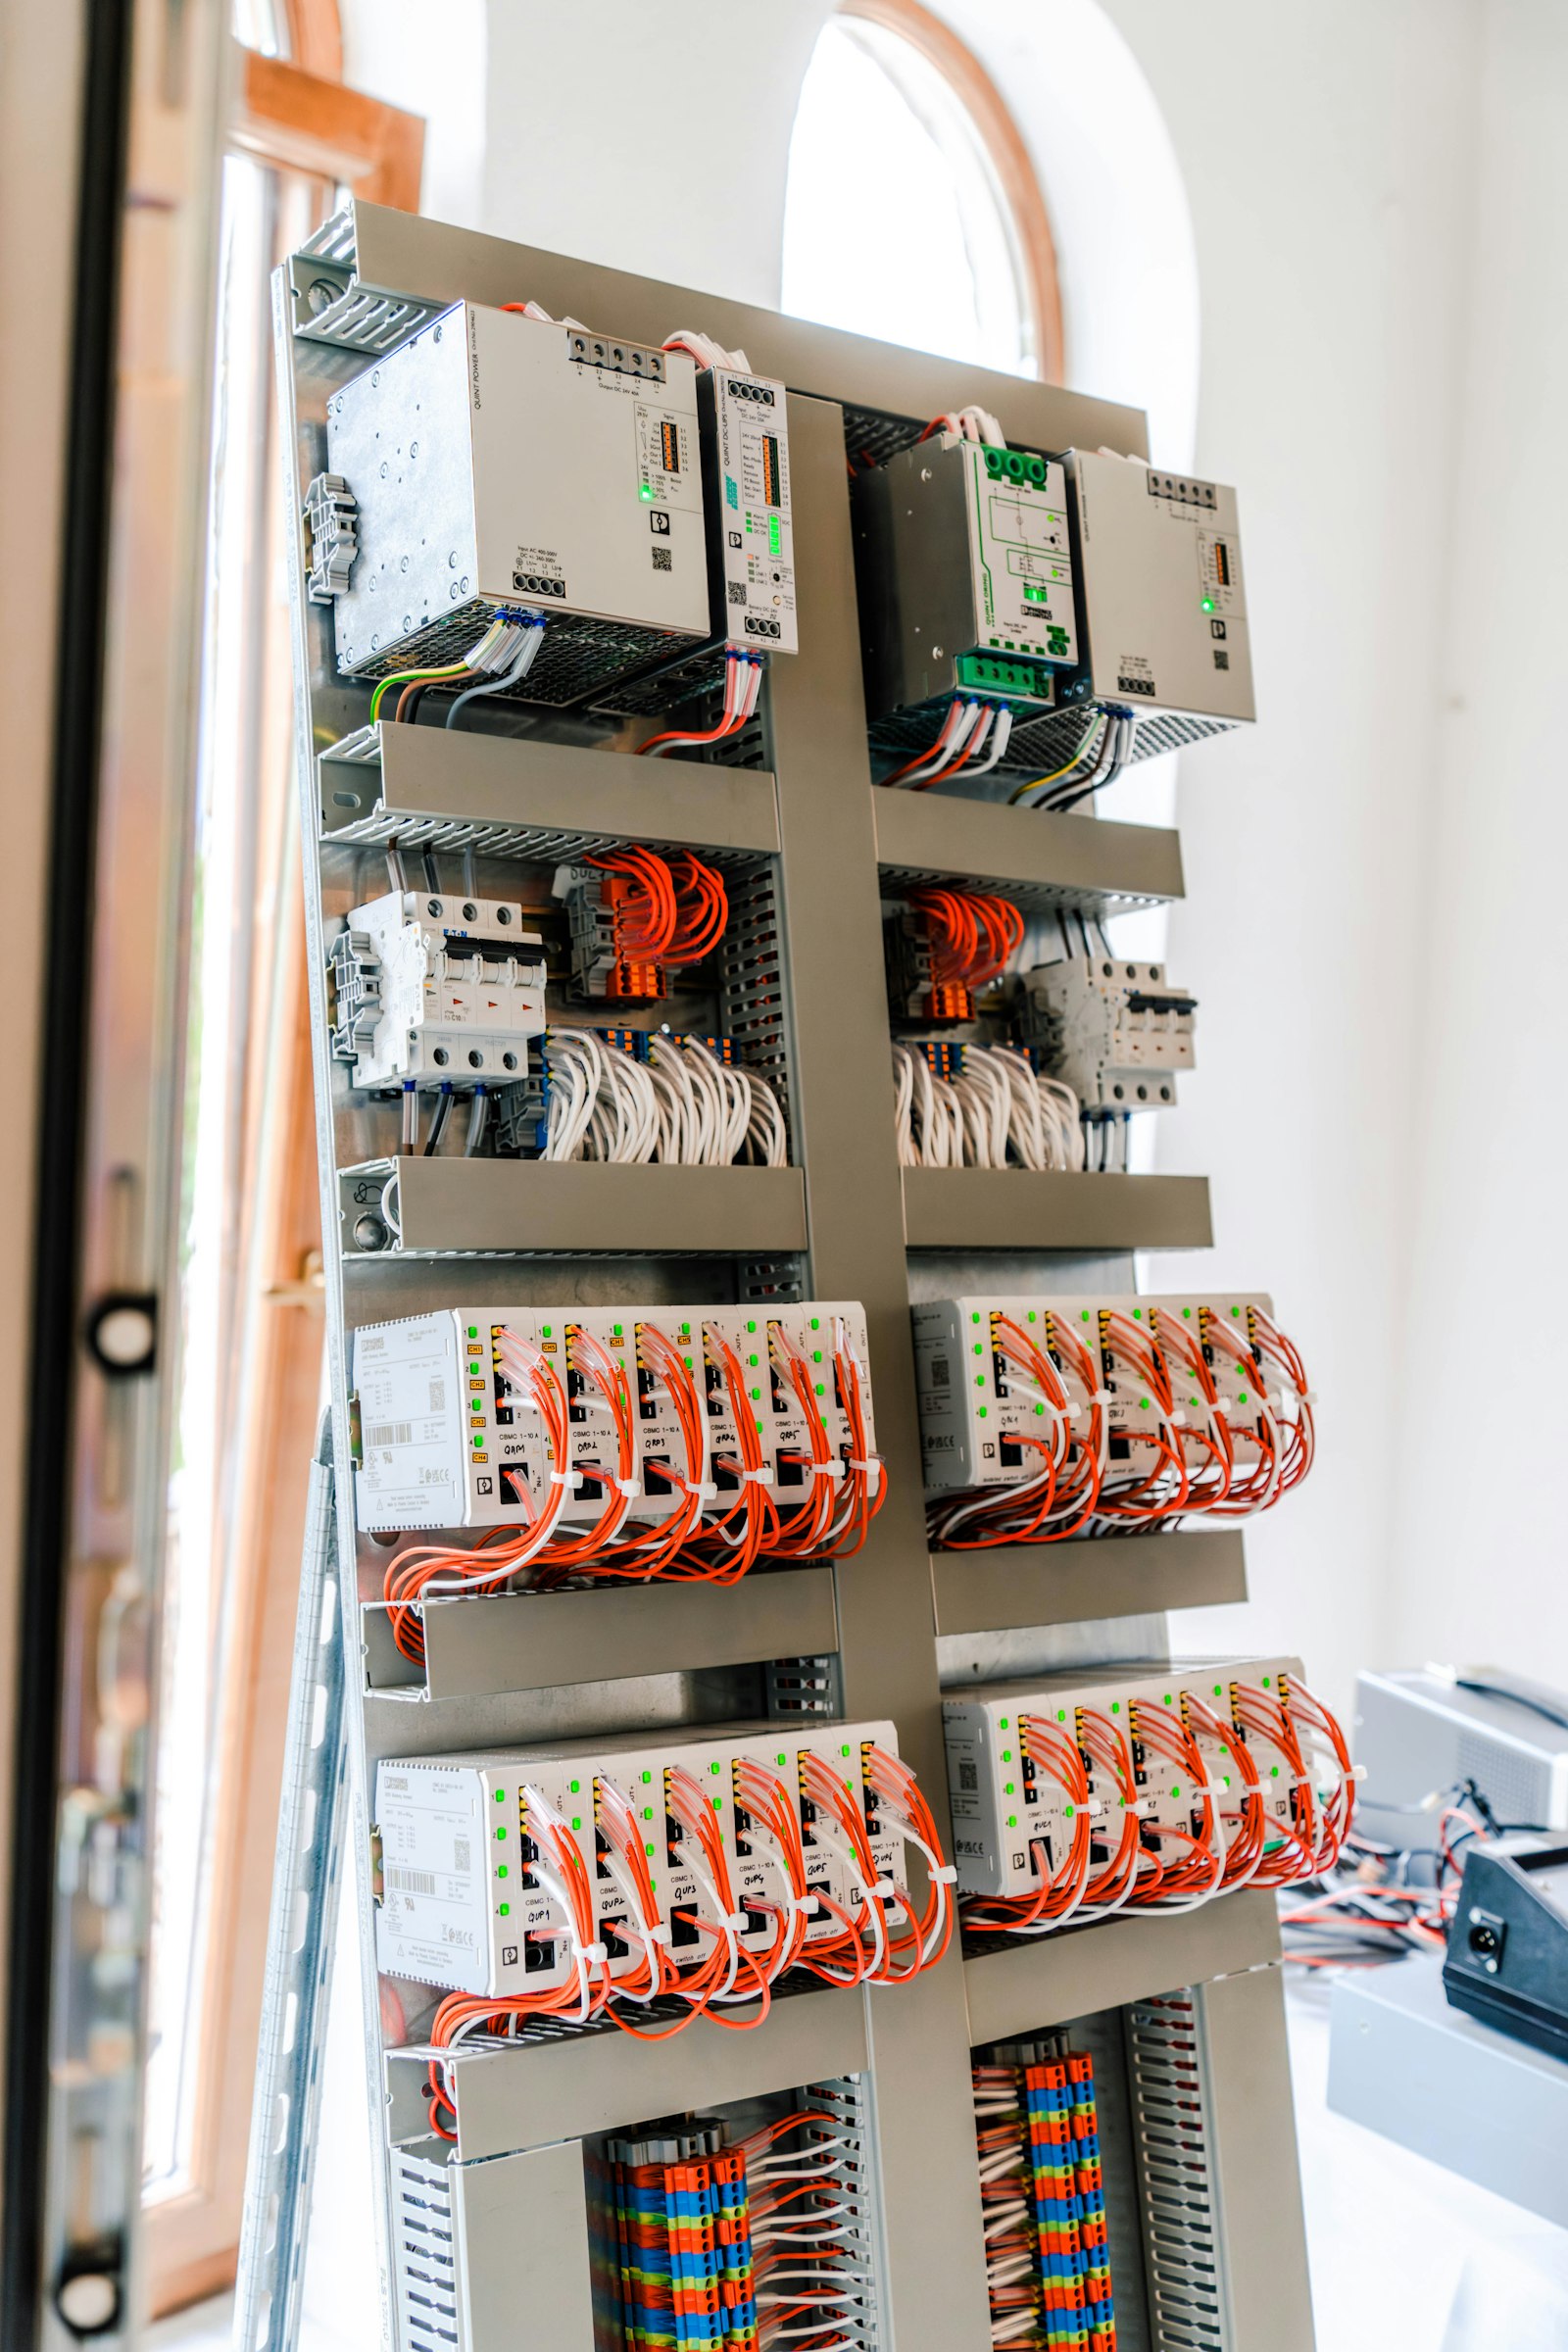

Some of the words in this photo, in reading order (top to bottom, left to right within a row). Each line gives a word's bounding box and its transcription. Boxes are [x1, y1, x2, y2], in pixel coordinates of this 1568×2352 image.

[674, 1885, 696, 1901] QUP3
[528, 1909, 550, 1923] QUP1
[675, 1955, 694, 1964] switch
